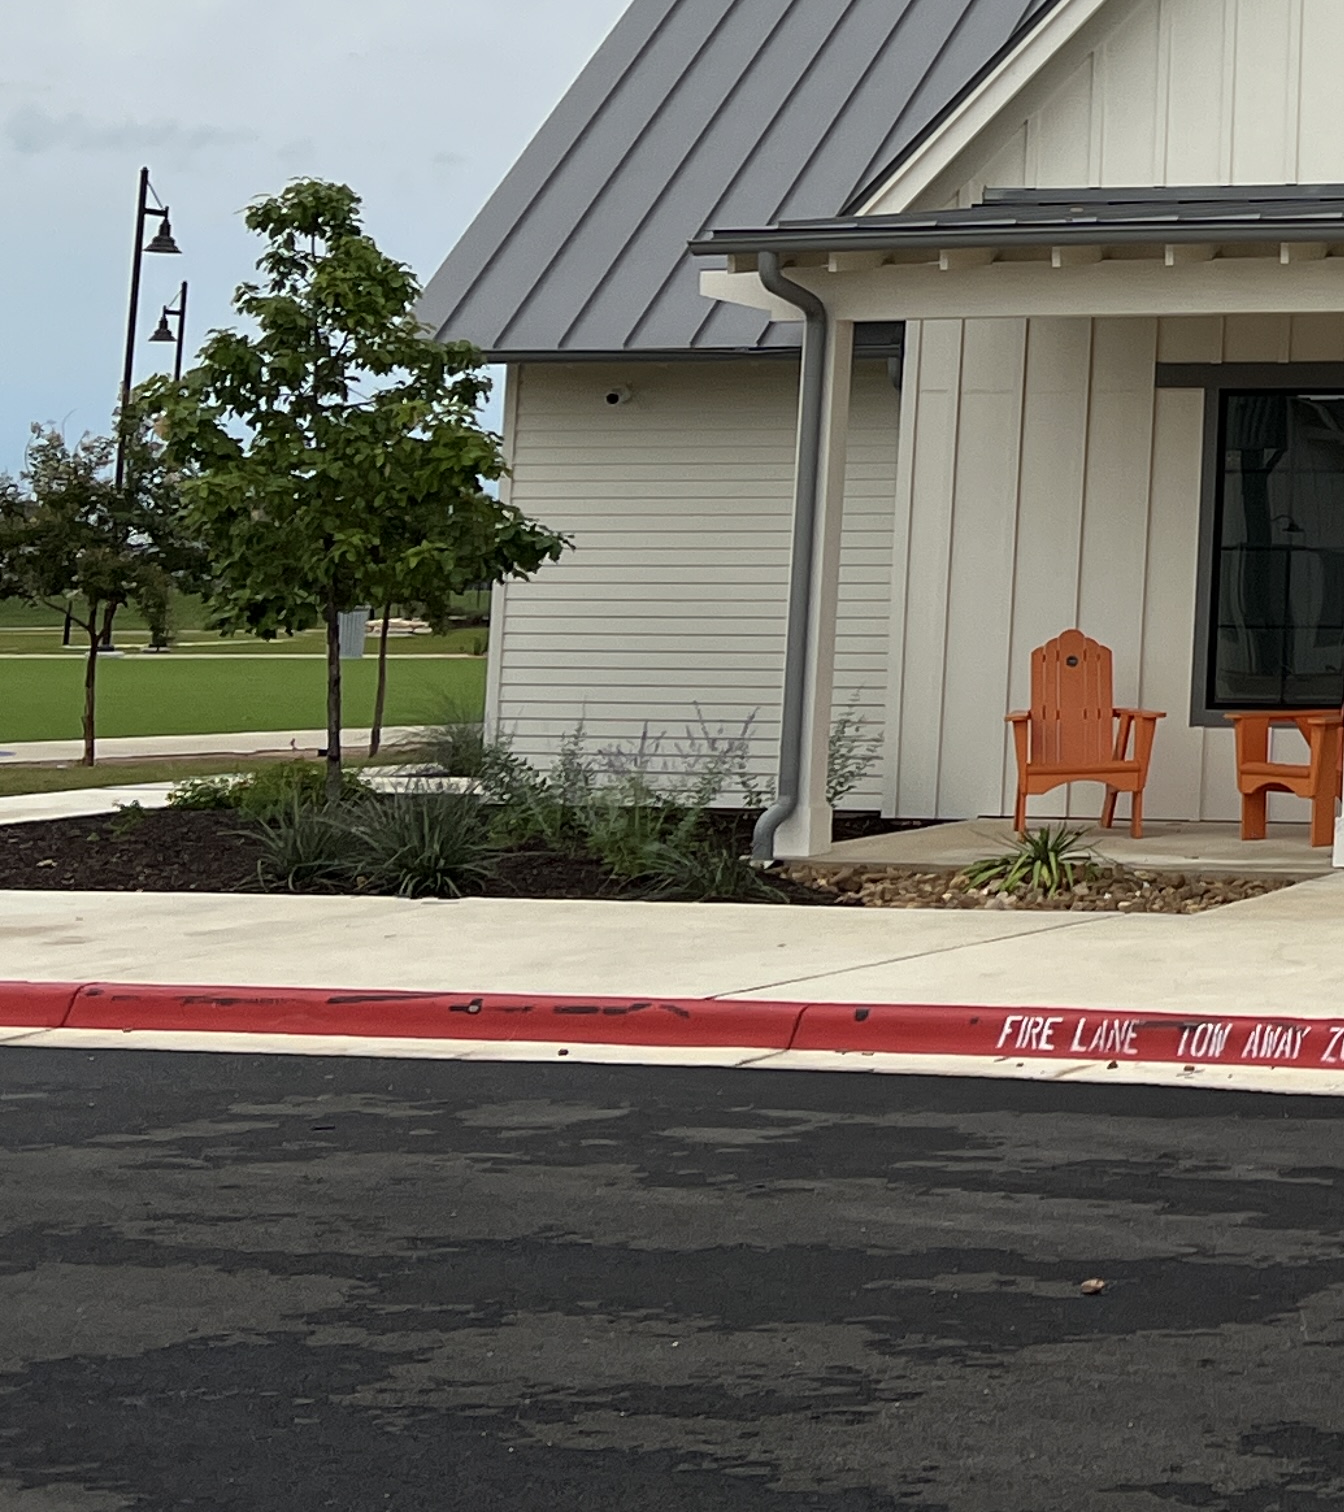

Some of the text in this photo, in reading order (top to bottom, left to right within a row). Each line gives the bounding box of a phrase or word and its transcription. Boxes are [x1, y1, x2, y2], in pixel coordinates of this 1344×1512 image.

[996, 1014, 1063, 1051] FIRE
[1070, 1017, 1139, 1055] LANE
[1177, 1022, 1233, 1058] TOW
[1241, 1023, 1311, 1060] AWAY
